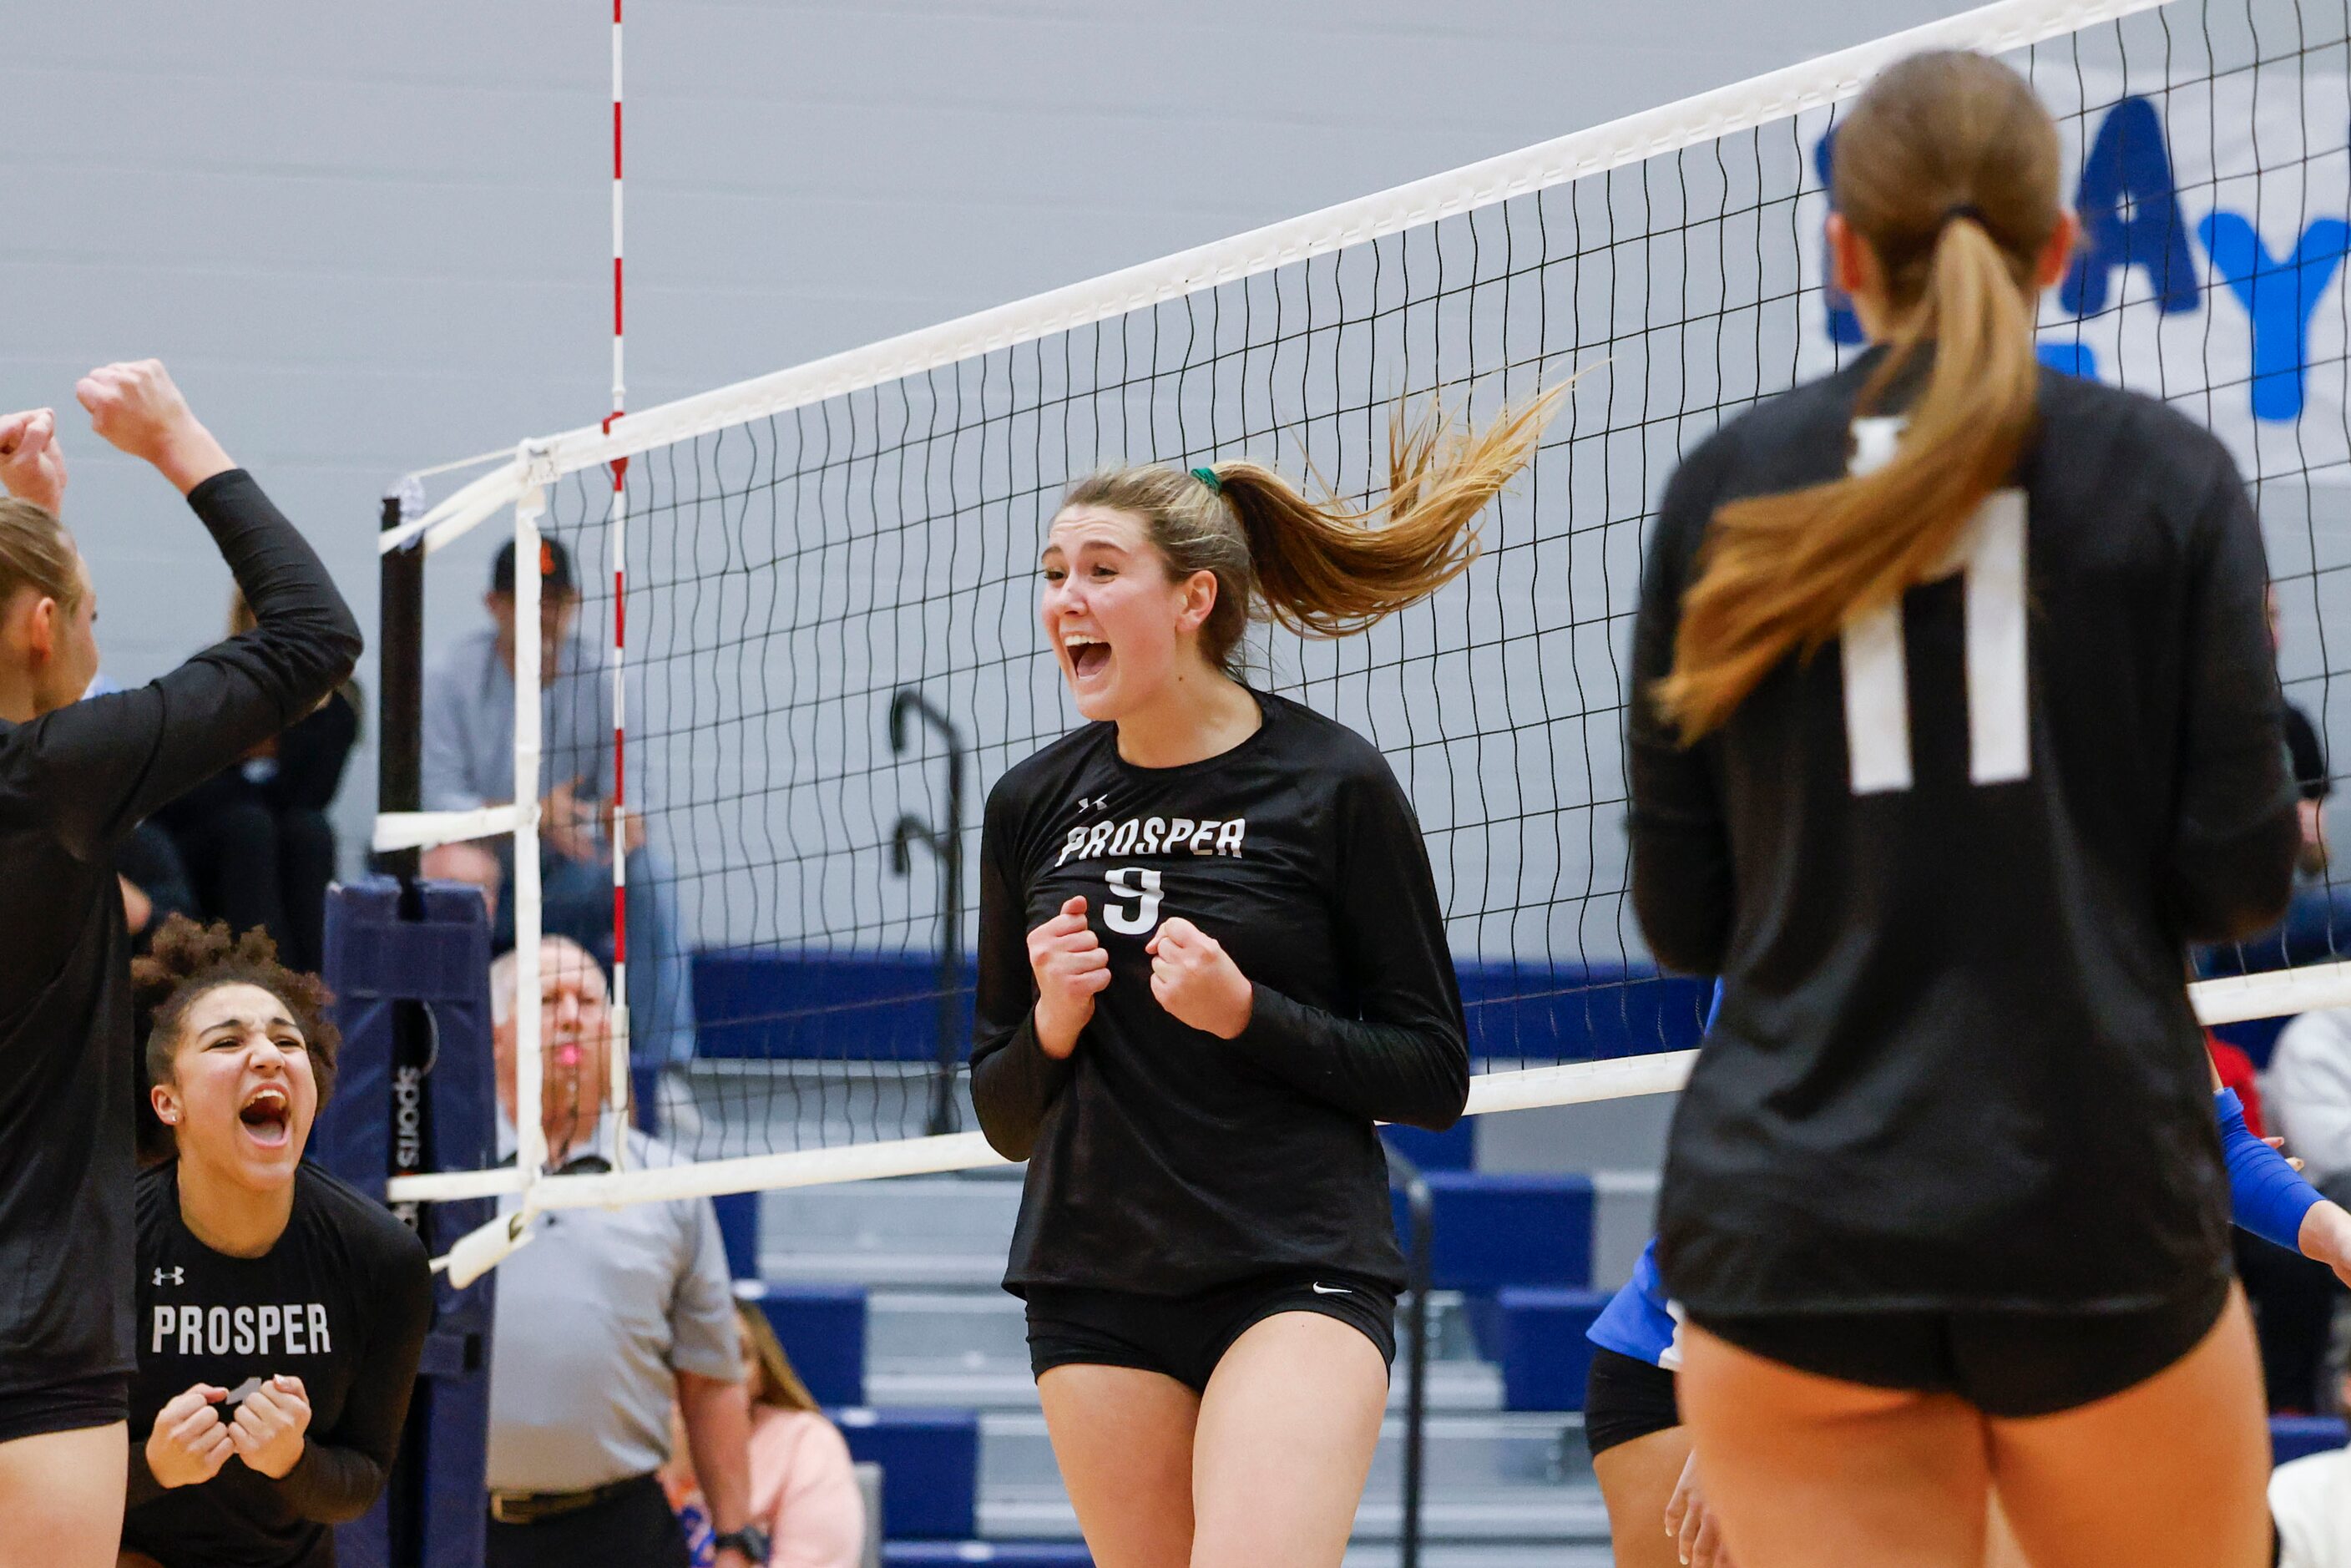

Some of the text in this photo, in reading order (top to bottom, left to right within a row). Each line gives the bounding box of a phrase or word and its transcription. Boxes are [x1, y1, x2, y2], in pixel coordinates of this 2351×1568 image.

[1054, 816, 1246, 868] PROSPER
[1102, 867, 1165, 936] 9
[151, 1303, 332, 1356] PROSPER
